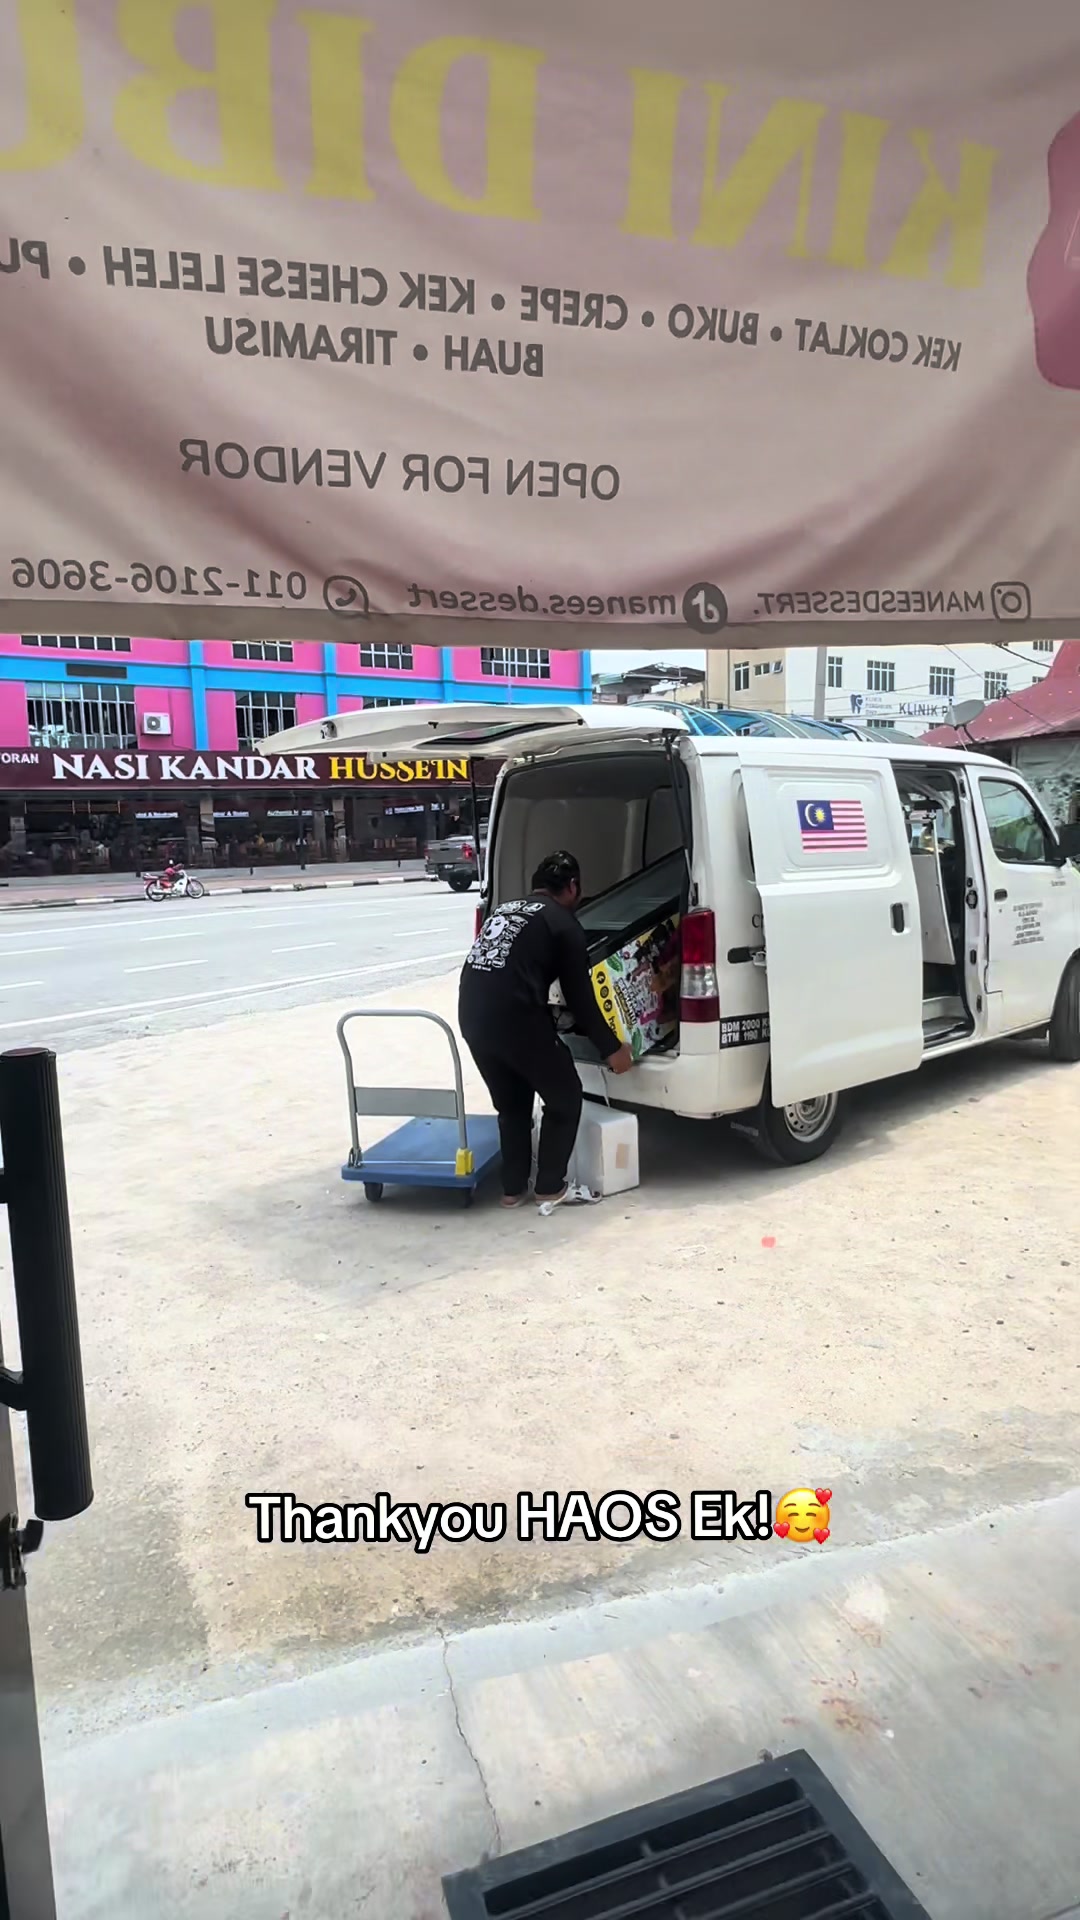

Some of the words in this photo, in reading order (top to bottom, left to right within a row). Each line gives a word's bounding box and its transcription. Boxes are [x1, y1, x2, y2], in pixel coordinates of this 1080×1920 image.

[899, 703, 937, 716] KLINIK
[0, 753, 39, 764] ORAN
[52, 753, 150, 780] NASI
[160, 756, 319, 781] KANDAR
[328, 756, 469, 782] HUSSEIN
[721, 1021, 740, 1033] BDM
[741, 1018, 760, 1031] 2000
[721, 1031, 740, 1044] BTM
